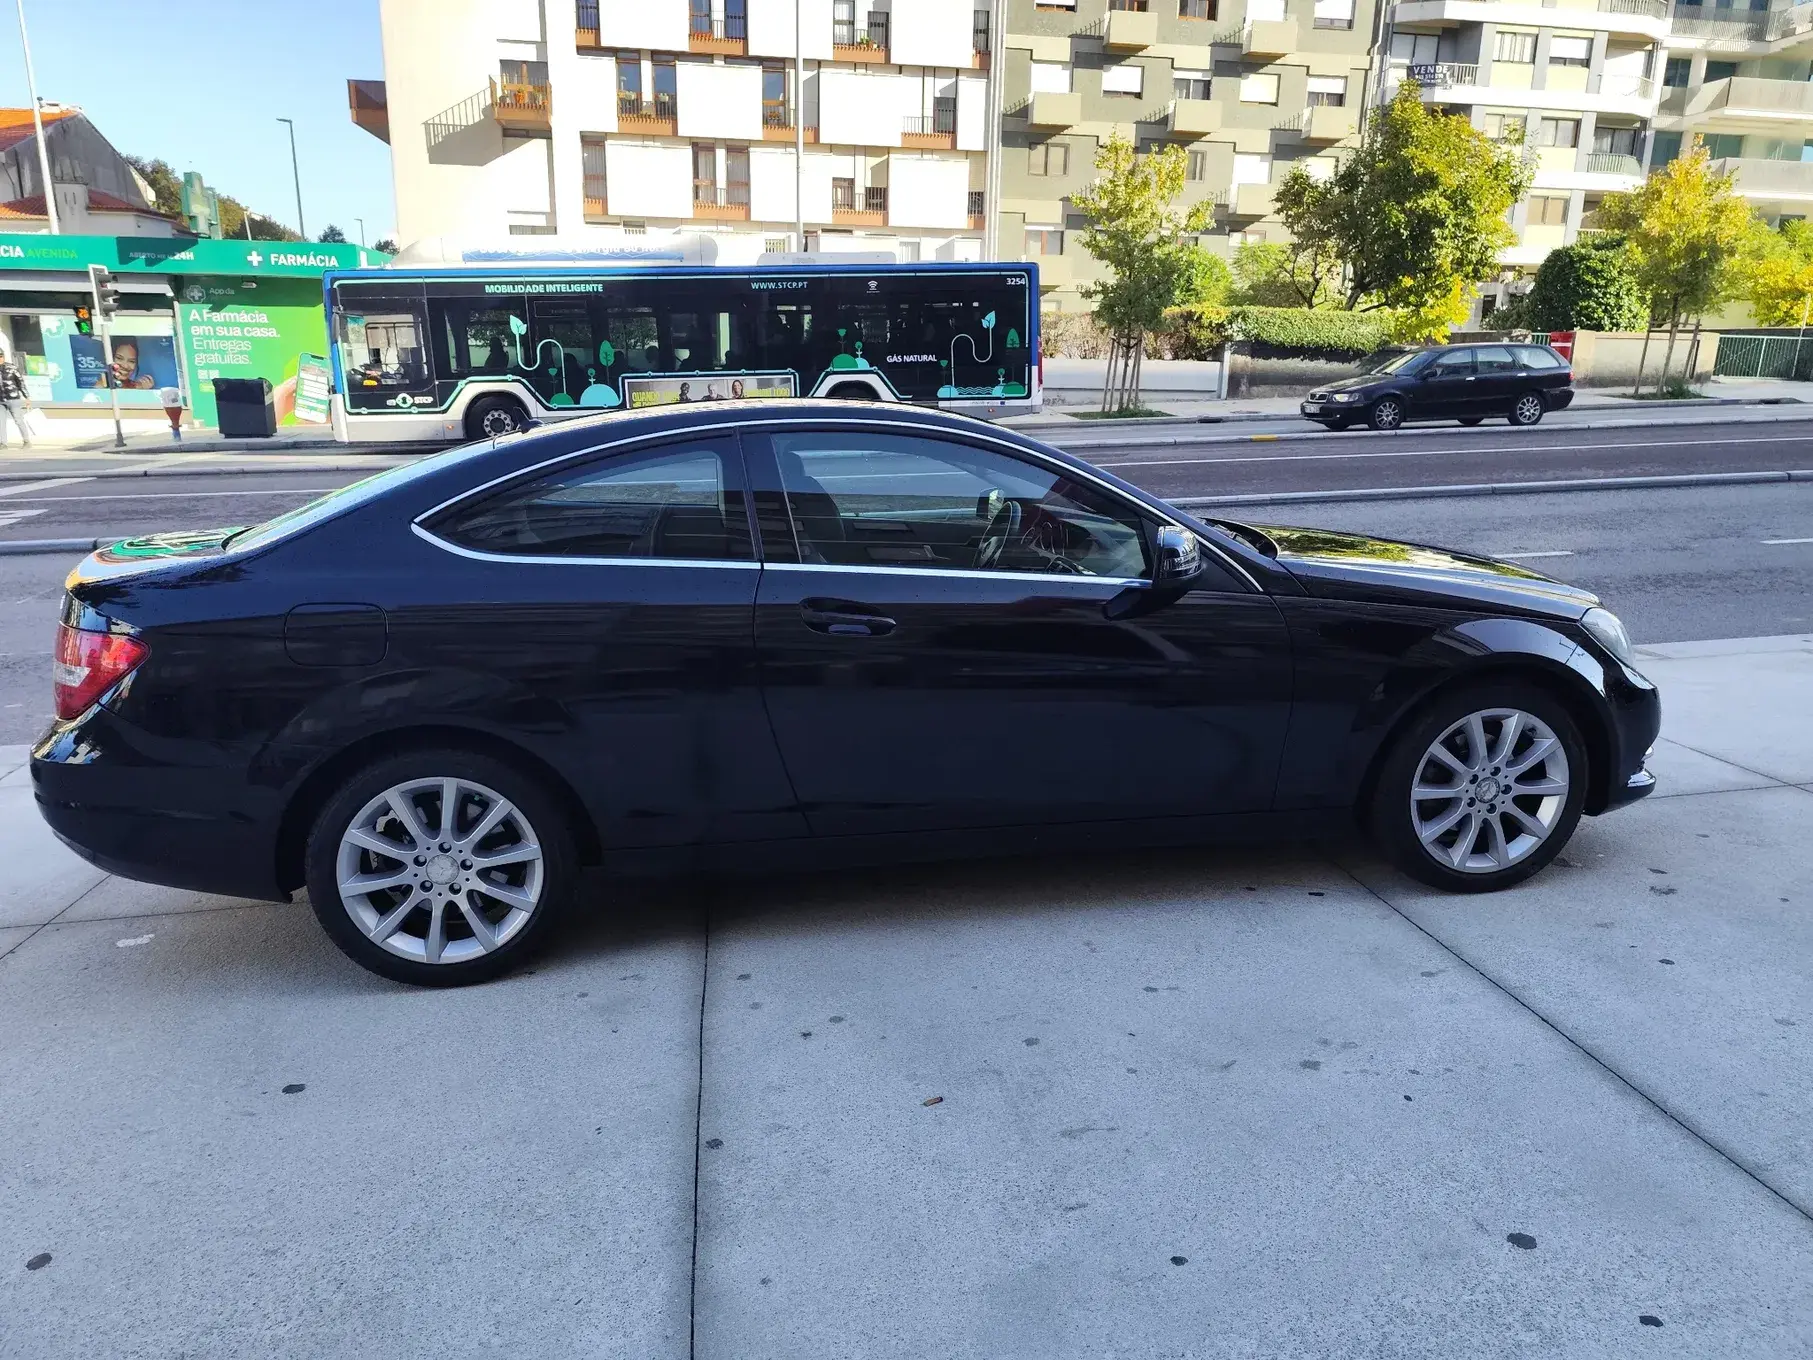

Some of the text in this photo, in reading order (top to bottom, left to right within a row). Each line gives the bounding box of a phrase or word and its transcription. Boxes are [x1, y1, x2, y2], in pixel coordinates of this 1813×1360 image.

[1413, 65, 1448, 74] VENDE
[27, 248, 78, 258] AVENIDA
[174, 251, 195, 260] 24H
[269, 251, 340, 267] FARMÁCIA
[751, 281, 808, 289] WWW.STCP.PT
[1006, 277, 1026, 285] 3254
[485, 283, 604, 293] MOBILIDADE INTELIGENTE
[189, 309, 269, 323] A Farmácia
[191, 325, 281, 338] em sua casa.
[193, 338, 251, 354] Entregas
[194, 352, 252, 367] gratuitas.
[886, 354, 938, 363] GÁS NATURAL
